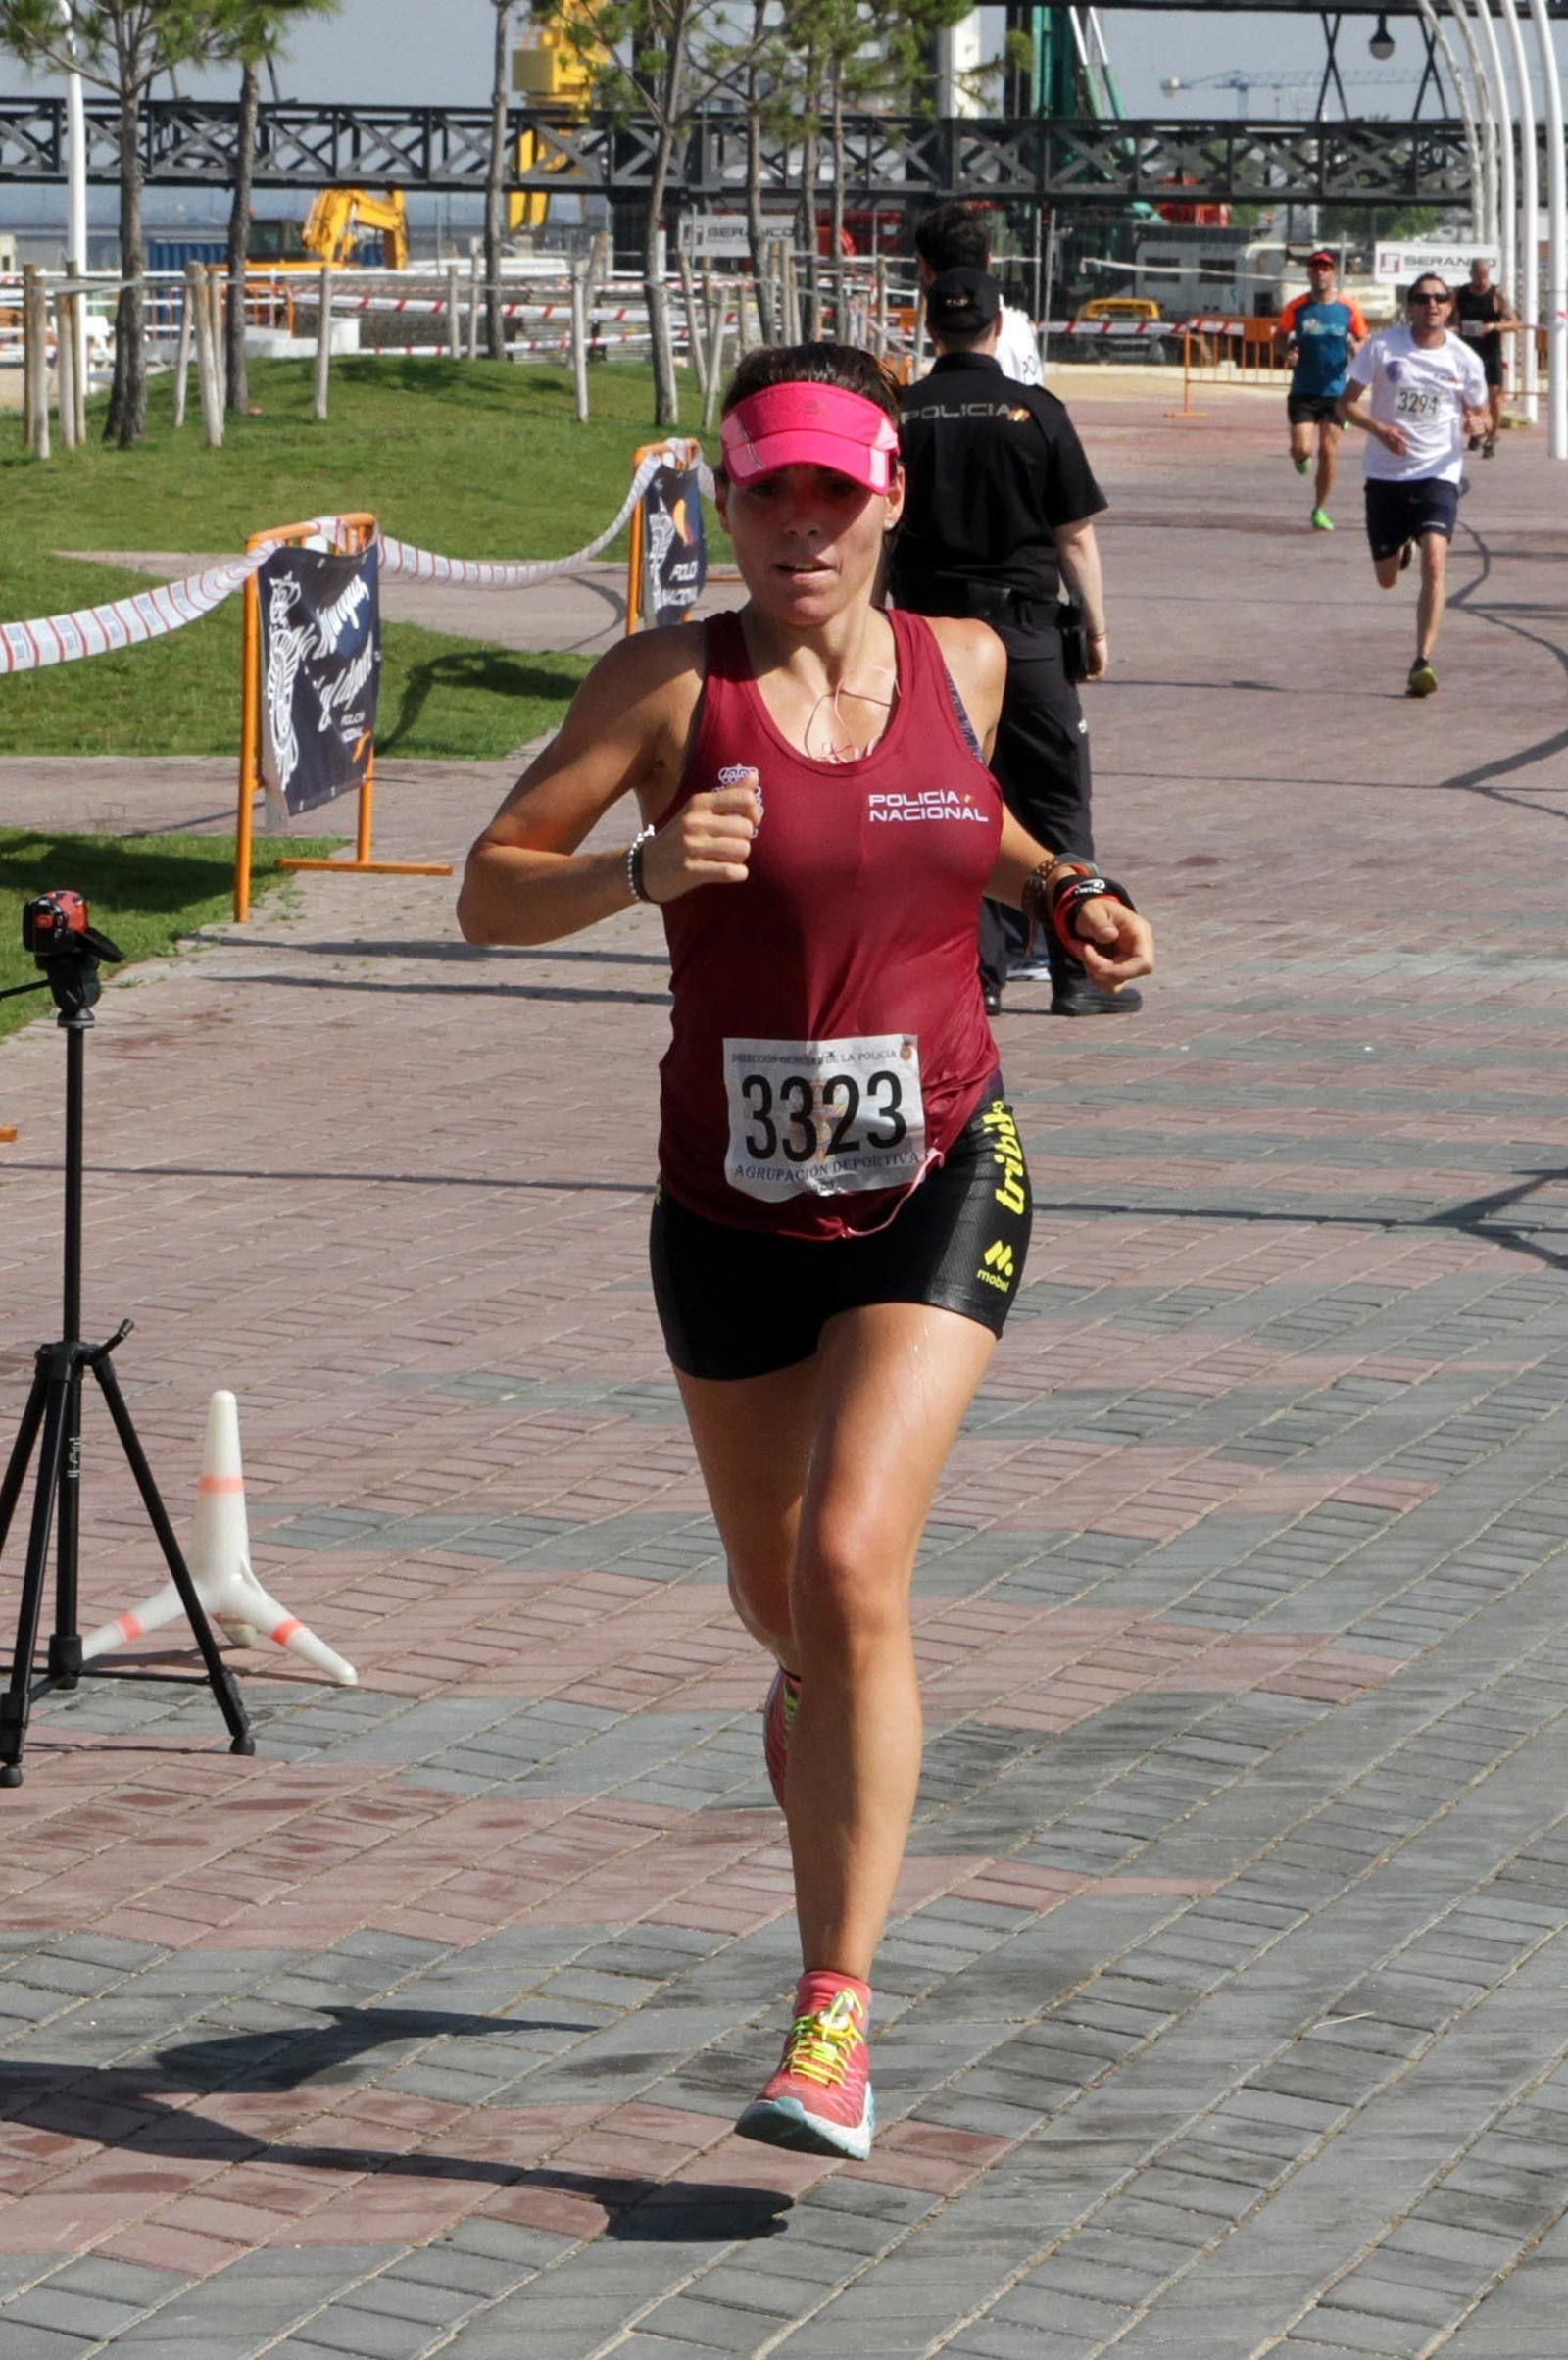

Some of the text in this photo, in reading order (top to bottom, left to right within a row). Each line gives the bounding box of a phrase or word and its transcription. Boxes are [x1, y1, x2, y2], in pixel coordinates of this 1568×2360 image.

[1403, 255, 1497, 267] SERANO
[1397, 391, 1439, 414] 3294
[869, 806, 989, 823] NACIONAL
[841, 1054, 855, 1062] LA
[741, 1070, 906, 1162] 3323
[833, 1151, 920, 1173] DEPORTIVA
